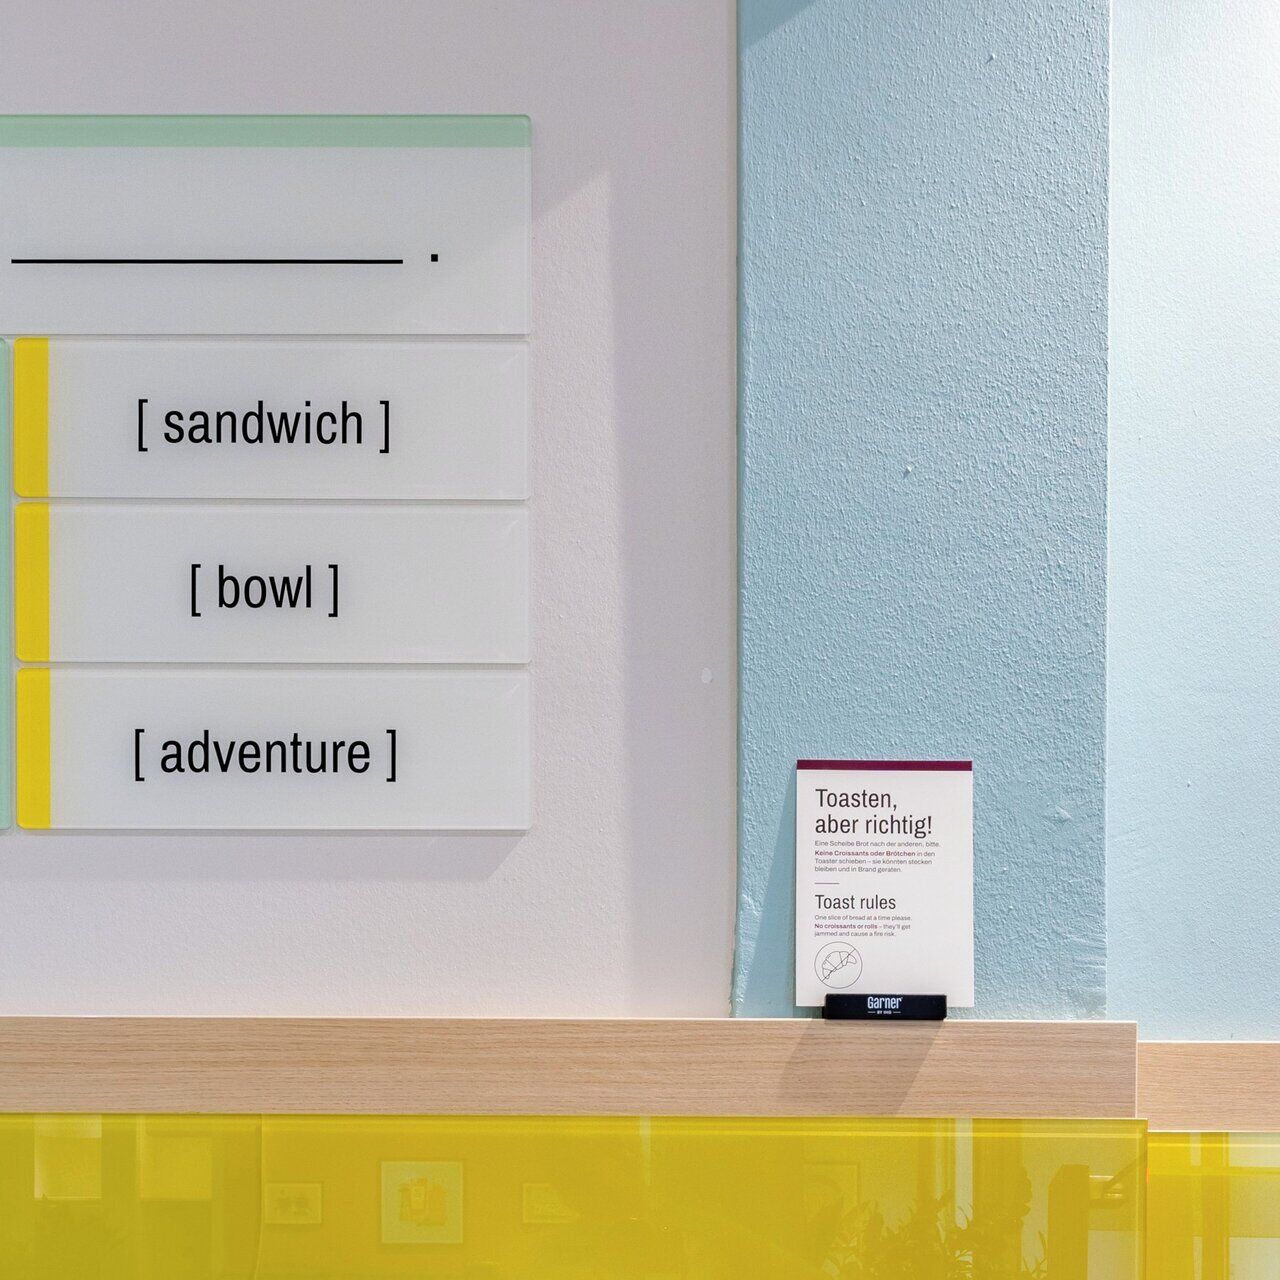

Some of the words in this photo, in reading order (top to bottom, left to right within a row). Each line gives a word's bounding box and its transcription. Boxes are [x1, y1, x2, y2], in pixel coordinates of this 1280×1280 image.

[163, 400, 363, 445] sandwich
[218, 564, 312, 609] bowl
[160, 729, 371, 774] adventure
[815, 788, 897, 812] Toasten,
[815, 814, 859, 834] aber
[865, 814, 932, 839] richtig!
[814, 894, 855, 910] Toast
[860, 894, 896, 910] rules
[867, 996, 902, 1009] Garner
